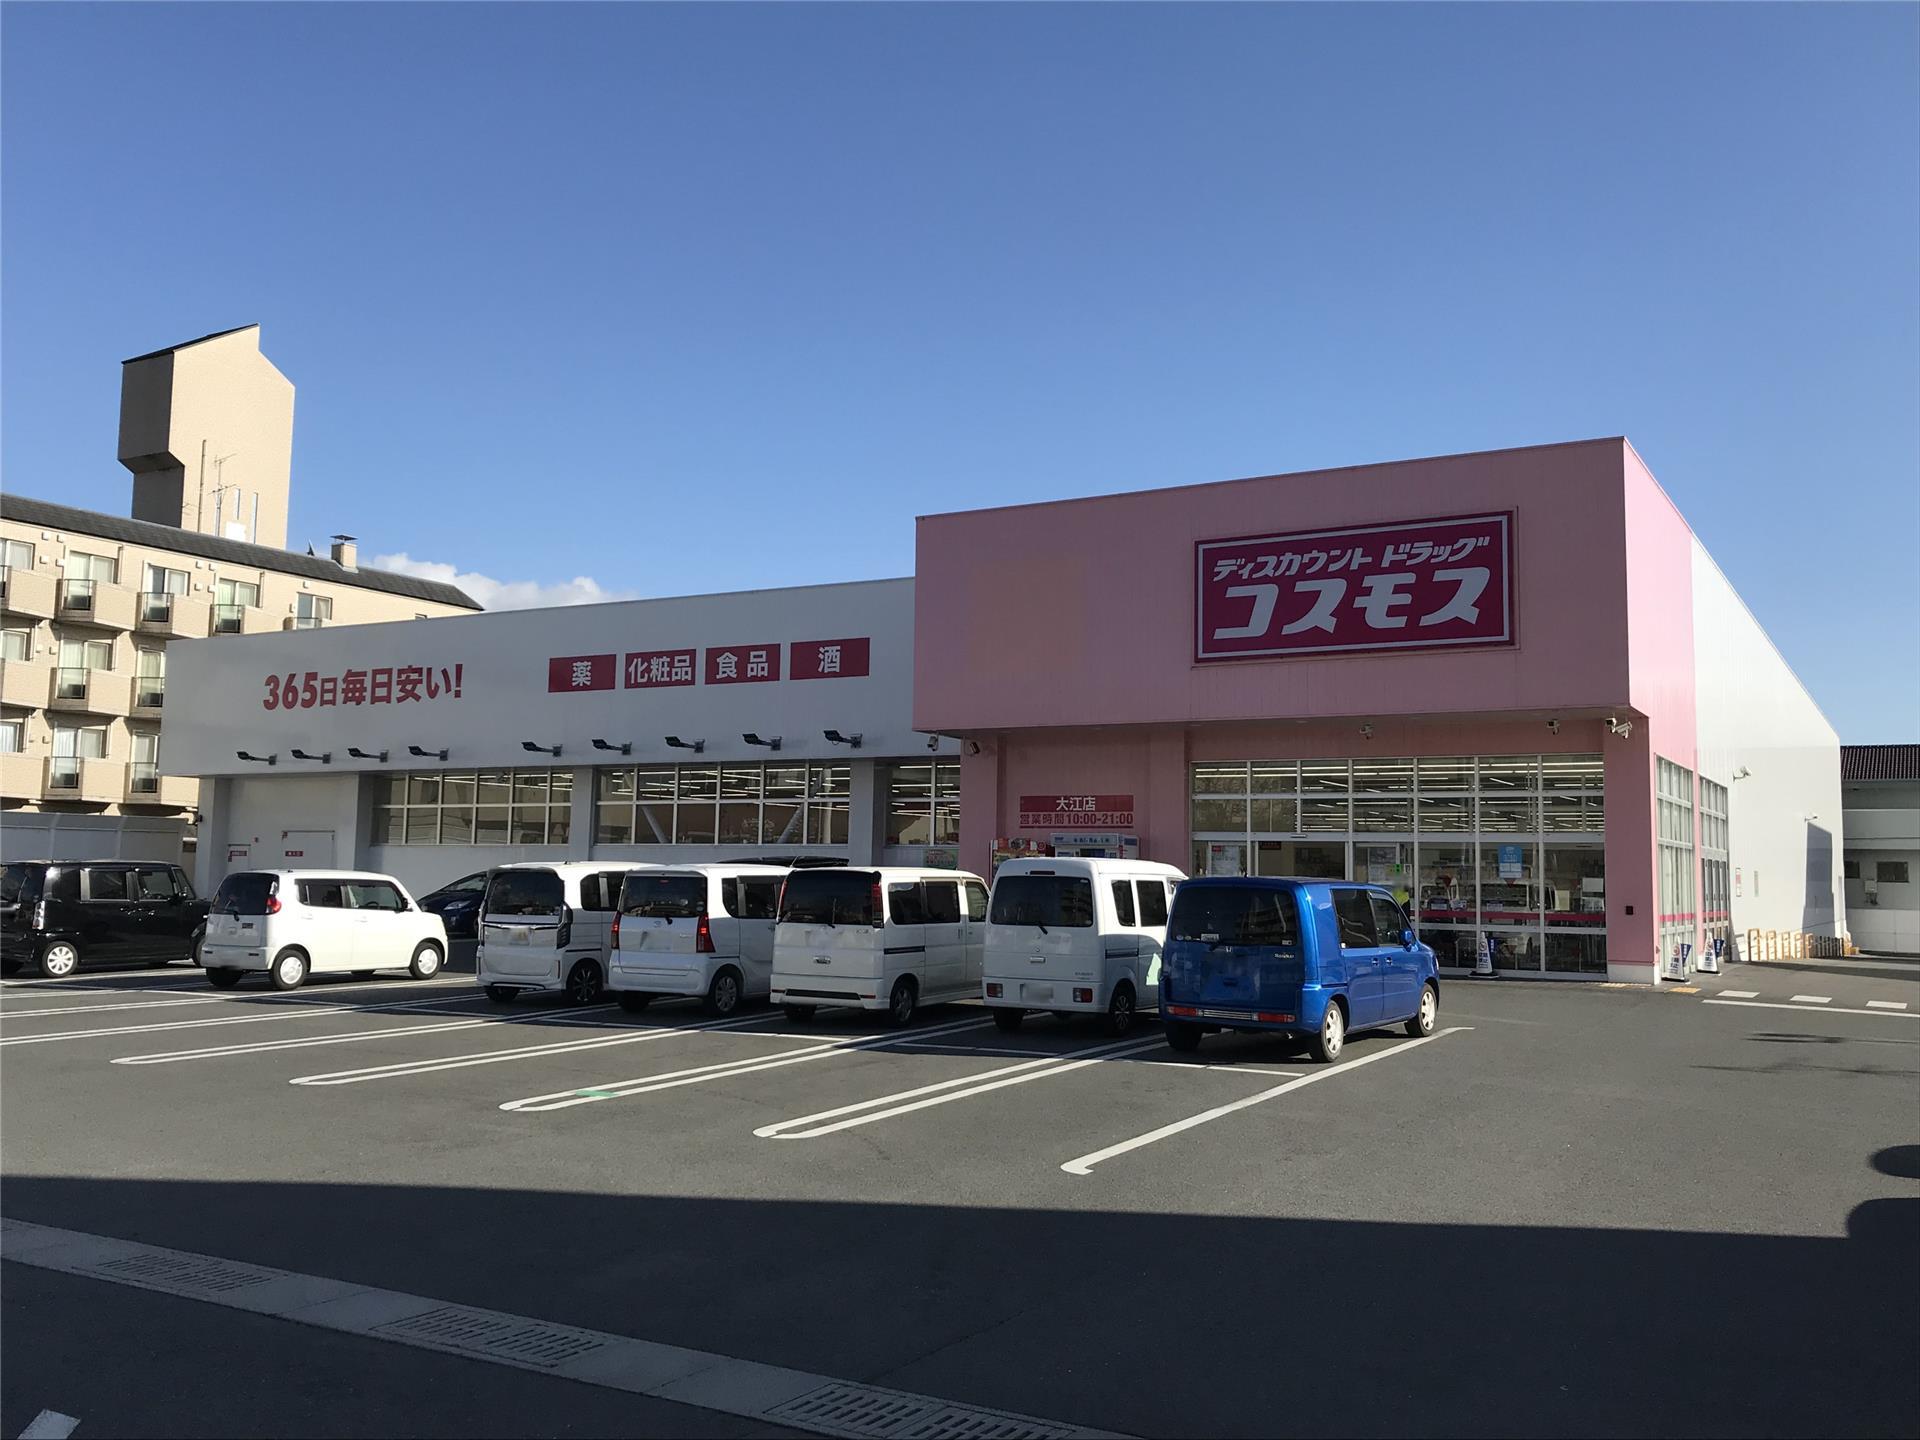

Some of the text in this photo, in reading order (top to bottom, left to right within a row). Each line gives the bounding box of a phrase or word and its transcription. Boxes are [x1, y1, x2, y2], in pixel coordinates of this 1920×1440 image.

[1213, 536, 1490, 582] ディスカウント ドラッグ
[1212, 567, 1490, 640] コスモス
[571, 660, 592, 687] 薬
[628, 654, 692, 684] 化粧品
[715, 650, 769, 679] 食品
[818, 645, 842, 673] 酒
[1056, 796, 1096, 811] 大江店
